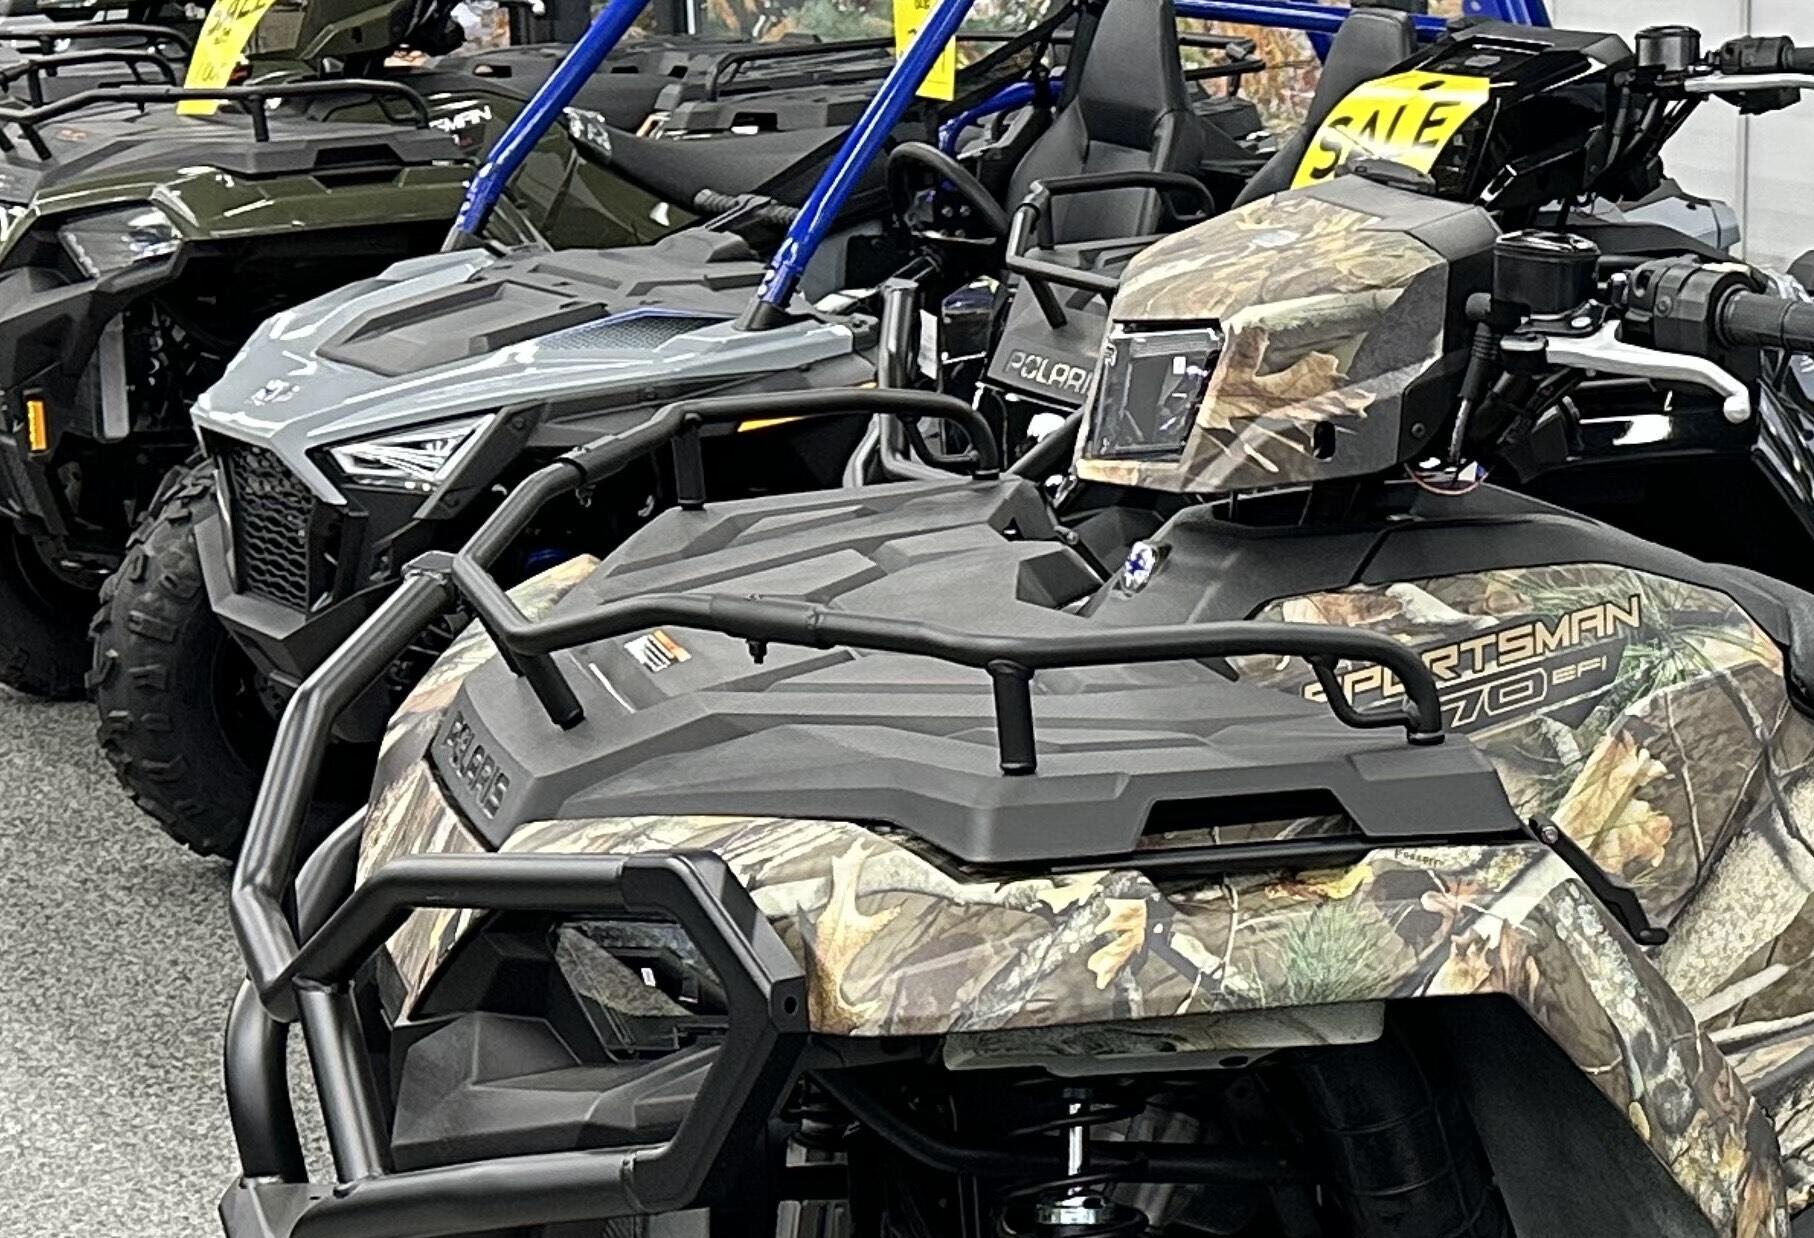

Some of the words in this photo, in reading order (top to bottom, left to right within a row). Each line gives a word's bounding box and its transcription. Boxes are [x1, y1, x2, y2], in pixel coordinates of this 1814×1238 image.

[1309, 100, 1463, 181] SALE
[1004, 349, 1095, 395] POLARI
[1437, 666, 1549, 730] 70
[1551, 653, 1609, 687] EFI
[443, 711, 511, 822] POLARIS
